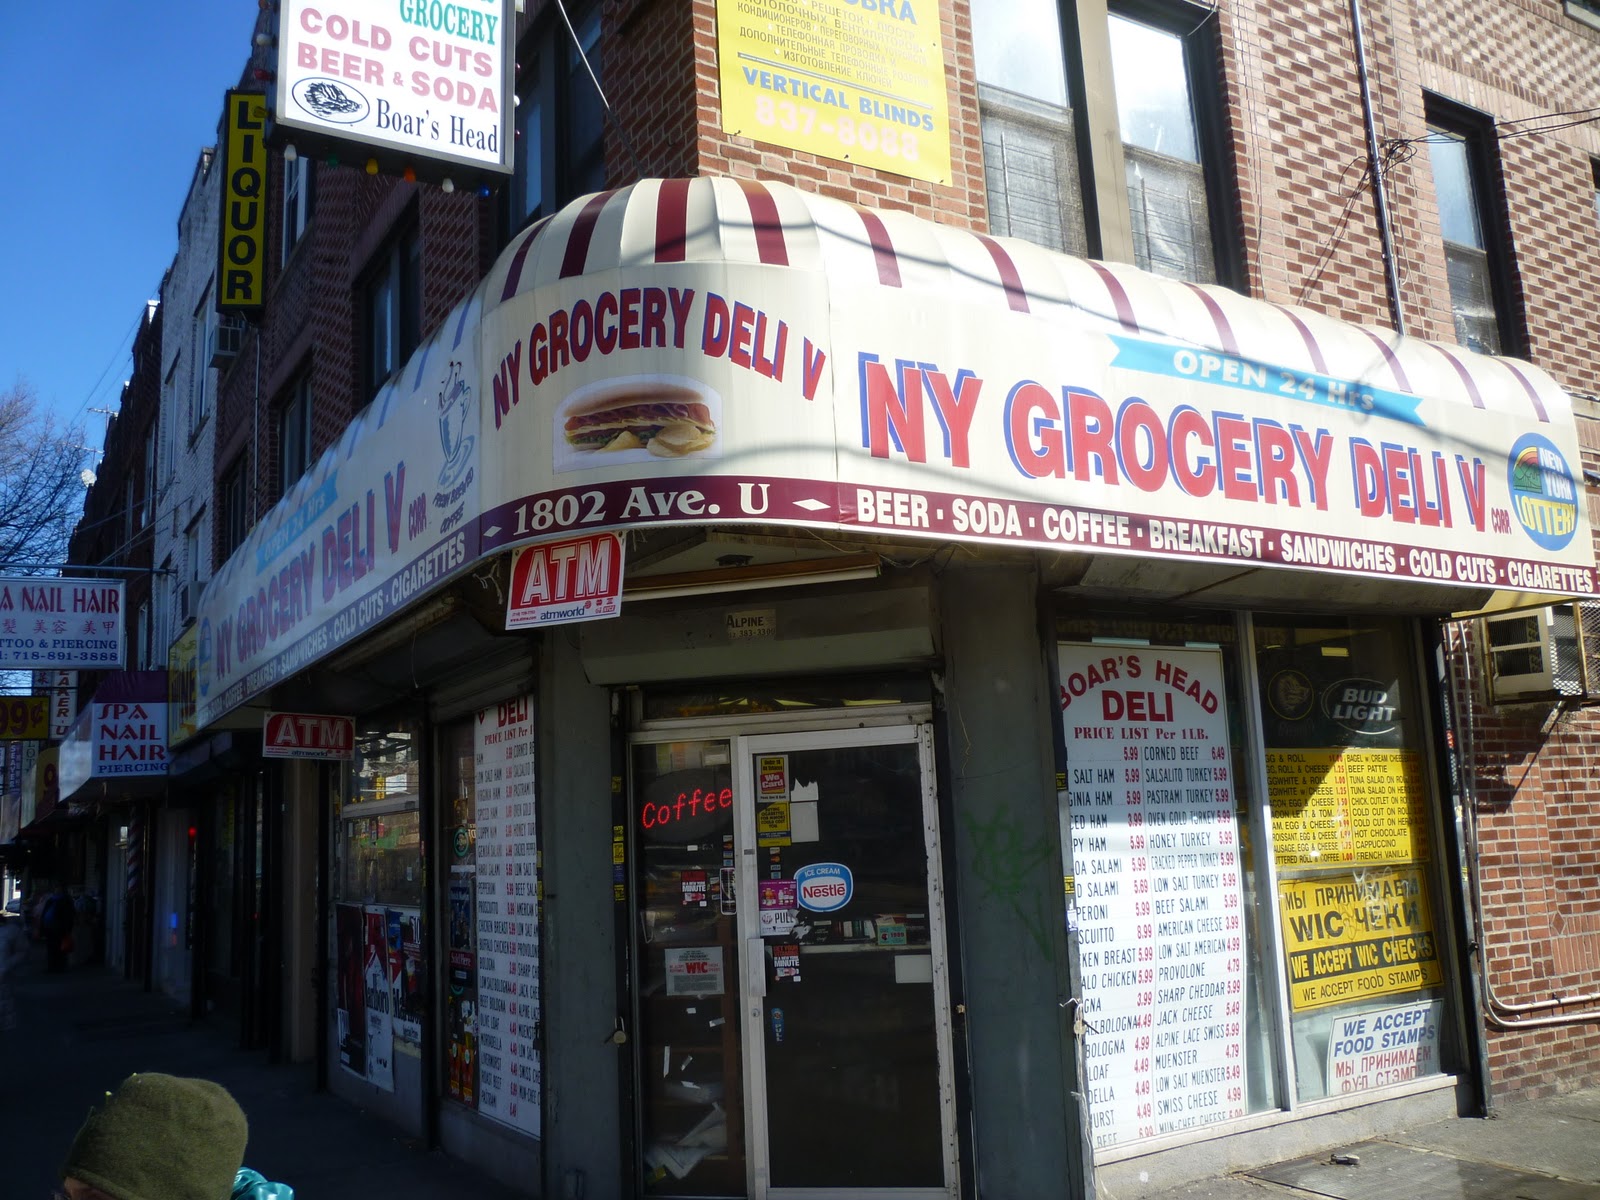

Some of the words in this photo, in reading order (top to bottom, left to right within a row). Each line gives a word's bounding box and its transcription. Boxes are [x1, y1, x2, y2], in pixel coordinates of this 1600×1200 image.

[400, 0, 498, 45] GROCERY
[737, 2, 813, 31] КОНДИЦИОНЕРОВ
[300, 8, 392, 51] COLD
[409, 36, 492, 77] CUTS
[739, 26, 826, 59] ДОПОЛНИТЕЛЬНЫЕ
[775, 24, 835, 50] ТЕЛЕФОННАЯ
[783, 50, 852, 77] ИЗГОТОВЛЕНИЕ
[297, 42, 385, 86] BEER
[392, 71, 404, 87] &
[411, 70, 499, 113] SODA
[742, 65, 850, 110] VERTICAL
[859, 96, 935, 132] BLINDS
[376, 98, 440, 140] Boar's
[450, 115, 499, 153] Head
[754, 94, 919, 161] 837-8088
[225, 101, 262, 300] LIQUOR
[492, 339, 521, 432] NY
[528, 287, 695, 387] GROCERY
[701, 291, 788, 383] DELI
[802, 336, 826, 401] V
[1173, 350, 1265, 388] OPEN
[1280, 371, 1317, 401] 24
[1328, 381, 1375, 411] Hrs
[858, 351, 984, 469] NY
[1003, 379, 1335, 512] GROCERY
[1349, 436, 1454, 529] DELI
[1455, 454, 1486, 532] V
[1538, 447, 1565, 472] NEW
[1541, 468, 1574, 501] YORK
[513, 491, 606, 536] 1802
[620, 486, 721, 519] Ave.
[737, 482, 771, 515] U
[1514, 494, 1577, 537] LOTTERY
[856, 488, 930, 529] BEER
[951, 499, 1022, 537] SODA
[1042, 507, 1131, 548] COFFEE
[1148, 519, 1264, 560] BREAKFAST
[1280, 532, 1397, 574] SANDWICHES
[1409, 548, 1452, 580] COLD
[1456, 557, 1497, 584] CUTS
[1507, 560, 1593, 593] CIGARETTES
[216, 614, 233, 679] NY
[236, 541, 315, 664] GROCERY
[321, 488, 375, 604] DELI
[384, 460, 405, 555] V
[520, 536, 613, 606] ATM
[22, 586, 66, 613] NAIL
[73, 588, 120, 614] HAIR
[333, 608, 357, 642] COLD
[359, 589, 384, 628] CUTS
[391, 531, 466, 607] CIGARETTES
[540, 605, 585, 620] atmworld
[727, 614, 764, 629] ALPINE
[33, 619, 67, 635] 美容
[83, 620, 116, 636] 美甲
[13, 651, 118, 662] 718-891-3888
[39, 639, 49, 649] &
[52, 639, 118, 650] PIERCING
[1155, 660, 1219, 715] HEAD
[1341, 688, 1388, 705] BUD
[98, 703, 149, 720] SPA
[497, 695, 528, 728] DELI
[1101, 690, 1174, 722] DELI
[1331, 704, 1397, 721] LIGHT
[101, 723, 162, 741] NAIL
[273, 715, 346, 748] ATM
[504, 728, 517, 742] LIST
[1073, 726, 1115, 740] PRICE
[1121, 727, 1150, 740] LIST
[1156, 728, 1176, 740] Per
[100, 744, 166, 762] HAIR
[1144, 746, 1176, 761] CORNED
[1179, 746, 1199, 760] BEEF
[1211, 746, 1225, 760] 6.49
[99, 762, 170, 774] PIERCING
[1074, 769, 1093, 784] SALT
[1098, 769, 1115, 783] HAM
[1125, 768, 1140, 783] 5.99
[761, 779, 784, 789] Card
[642, 788, 733, 829] Coffee
[1150, 833, 1176, 850] HONEY
[1180, 832, 1211, 848] TURKEY
[1218, 831, 1233, 845] 5.99
[1354, 829, 1368, 838] HOT
[1370, 828, 1408, 838] CHOCOLATE
[1355, 839, 1396, 849] CAPPUCCINO
[1357, 852, 1382, 861] FRENCH
[1385, 850, 1409, 860] VANILLA
[804, 870, 815, 878] ICE
[816, 867, 841, 876] CREAM
[1155, 898, 1175, 915] BEEF
[1179, 896, 1209, 913] SALAMI
[1223, 894, 1238, 909] 5.99
[1285, 891, 1306, 910] МЫ
[1315, 876, 1420, 907] ПРИНИМАЕМ
[1157, 920, 1194, 937] AMERICAN
[1196, 917, 1223, 934] CHEESE
[1225, 915, 1239, 930] 3.99
[1289, 910, 1345, 942] WIC
[1354, 901, 1420, 932] ЧЕКИ
[685, 962, 708, 974] WIC
[774, 959, 800, 968] MINUTE
[1158, 961, 1206, 982] PROVOLONE
[1226, 958, 1240, 973] 4.79
[1291, 954, 1309, 979] WE
[1313, 948, 1352, 976] ACCEPT
[1355, 942, 1379, 968] WIC
[1382, 935, 1433, 964] CHECKS
[1157, 986, 1186, 1004] SHARP
[1189, 981, 1226, 1001] CHEDDAR
[1226, 980, 1241, 995] 5.99
[1302, 987, 1316, 1002] WE
[1320, 980, 1354, 997] ACCEPT
[1357, 974, 1385, 990] FOOD
[1389, 967, 1428, 986] STAMPS
[1156, 1009, 1178, 1027] JACK
[1182, 1004, 1214, 1023] CHEESE
[1225, 1001, 1240, 1017] 5.49
[1343, 1018, 1367, 1037] WE
[1373, 1008, 1430, 1032] ACCEPT
[1334, 1036, 1374, 1058] FOOD
[1381, 1024, 1436, 1049] STAMPS
[1155, 1050, 1198, 1070] MUENSTER
[1225, 1043, 1240, 1059] 4.79
[1335, 1059, 1354, 1079] МЫ
[1361, 1045, 1431, 1073] ПРИНИМАЕМ
